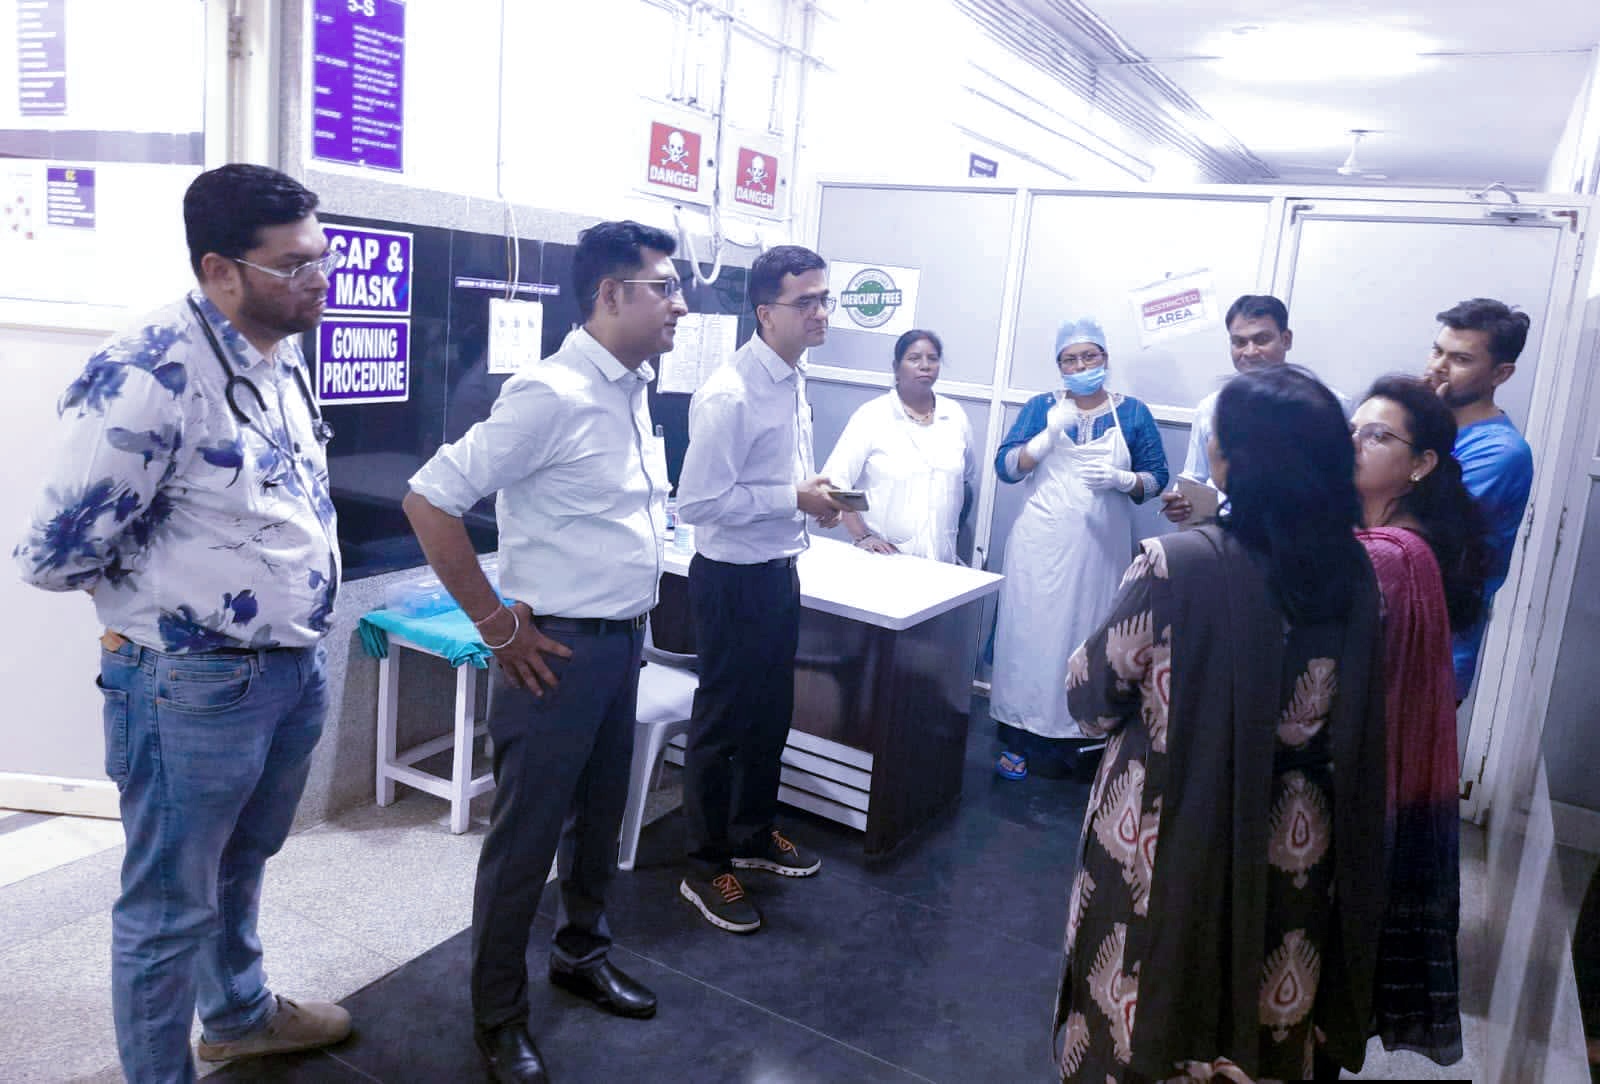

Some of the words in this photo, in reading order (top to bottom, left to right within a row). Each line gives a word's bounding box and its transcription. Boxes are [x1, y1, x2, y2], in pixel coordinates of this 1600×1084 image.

[649, 165, 698, 189] DANGER
[736, 186, 775, 206] DANGER
[330, 234, 380, 271] CAP
[386, 241, 404, 273] &
[335, 273, 397, 307] MASK
[841, 292, 880, 305] MERCURY
[881, 291, 901, 305] FREE
[1156, 308, 1193, 325] AREA
[332, 327, 398, 359] GOWNING
[322, 360, 405, 393] PROCEDURE
